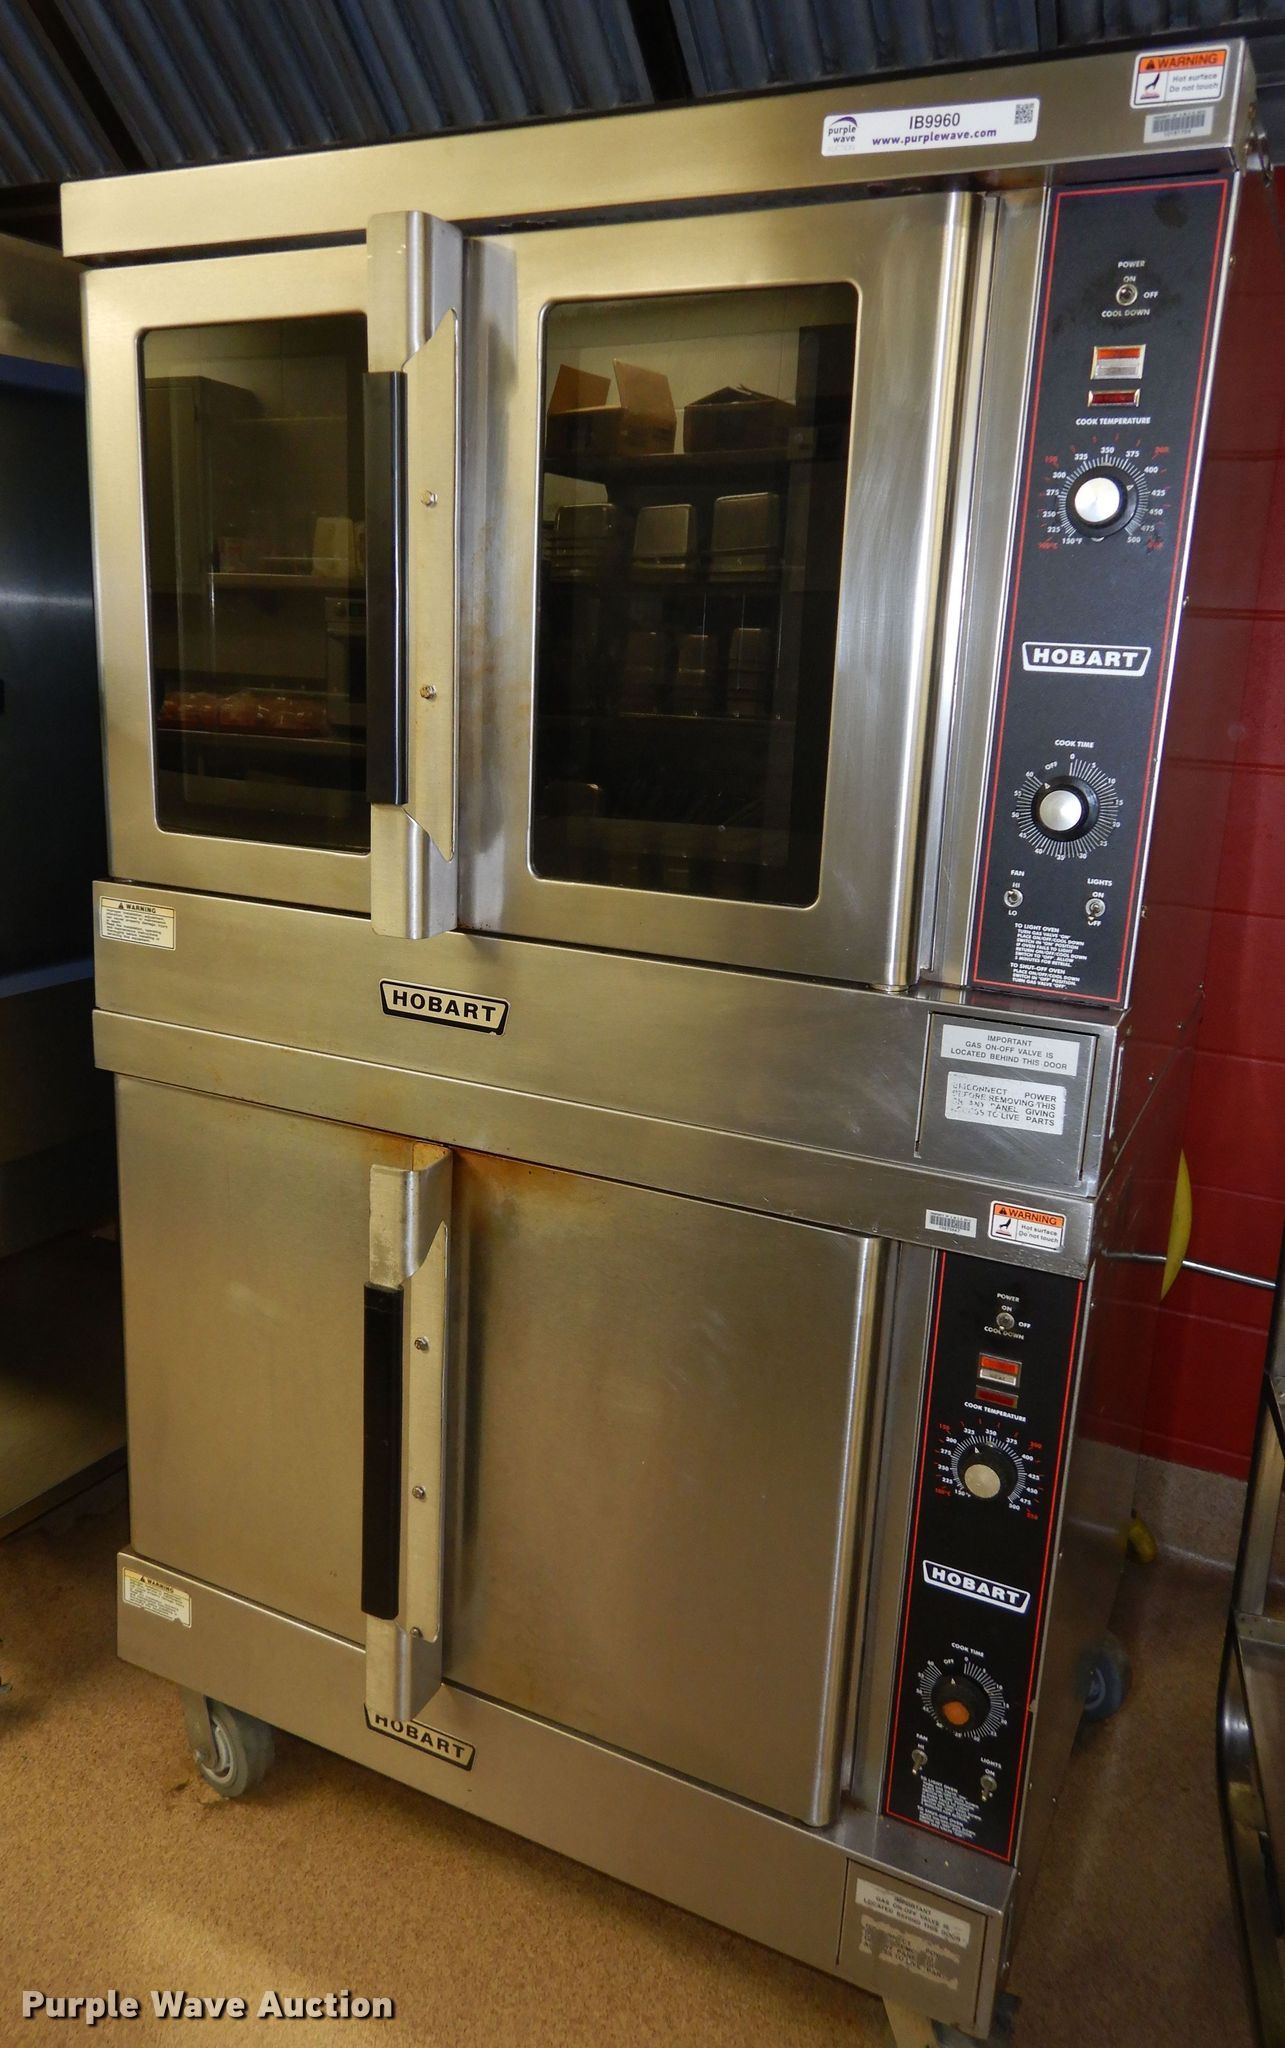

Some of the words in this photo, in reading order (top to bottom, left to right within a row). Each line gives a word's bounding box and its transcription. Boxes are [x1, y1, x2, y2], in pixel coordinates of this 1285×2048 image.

[1158, 53, 1217, 68] WARNING
[1196, 82, 1218, 90] touch
[909, 112, 960, 130] IB9960
[828, 125, 856, 135] purple
[833, 135, 855, 143] wave
[872, 128, 996, 145] www.purplewave.com
[1117, 260, 1145, 268] POWER
[1101, 309, 1122, 317] COOL
[1124, 308, 1150, 316] DOWN
[1099, 417, 1150, 425] TEMPERATURE
[1100, 446, 1114, 454] 350
[1149, 508, 1163, 516] 450
[1033, 647, 1138, 667] HOBART
[1044, 761, 1057, 770] OFF
[1087, 877, 1112, 886] LIGHTS
[126, 904, 156, 913] WARNING
[1019, 963, 1047, 971] SHUT-OFF
[392, 989, 496, 1022] HOBART
[987, 1035, 1032, 1046] IMPORTANT
[965, 1040, 981, 1048] GAS
[985, 1043, 1014, 1052] ON-OFF
[1018, 1048, 1041, 1057] VALVE
[950, 1047, 986, 1058] LOCATED
[989, 1054, 1019, 1063] BEHIND
[1022, 1057, 1039, 1066] THIS
[1043, 1061, 1067, 1070] DOOR
[1024, 1092, 1056, 1102] POWER
[988, 1095, 1034, 1107] REMOVING
[1036, 1101, 1056, 1110] THIS
[1025, 1108, 1055, 1118] GIVING
[1000, 1113, 1019, 1121] LIVE
[1025, 1116, 1054, 1126] PARTS
[1008, 1208, 1056, 1225] WARNING
[1033, 1227, 1057, 1236] surface
[1040, 1234, 1058, 1242] touch
[996, 1292, 1019, 1302] POWER
[984, 1325, 1001, 1335] COOL
[1002, 1330, 1024, 1340] DOWN
[964, 1401, 982, 1411] COOK
[984, 1406, 1026, 1422] TEMPERATURE
[1021, 1453, 1033, 1461] 400
[931, 1567, 1019, 1604] HOBART
[951, 1642, 968, 1652] COOK
[970, 1648, 984, 1657] TIME
[375, 1714, 464, 1758] HOBART
[916, 1732, 928, 1741] FAN
[980, 1756, 1002, 1769] LIGHTS
[984, 1768, 995, 1776] ON
